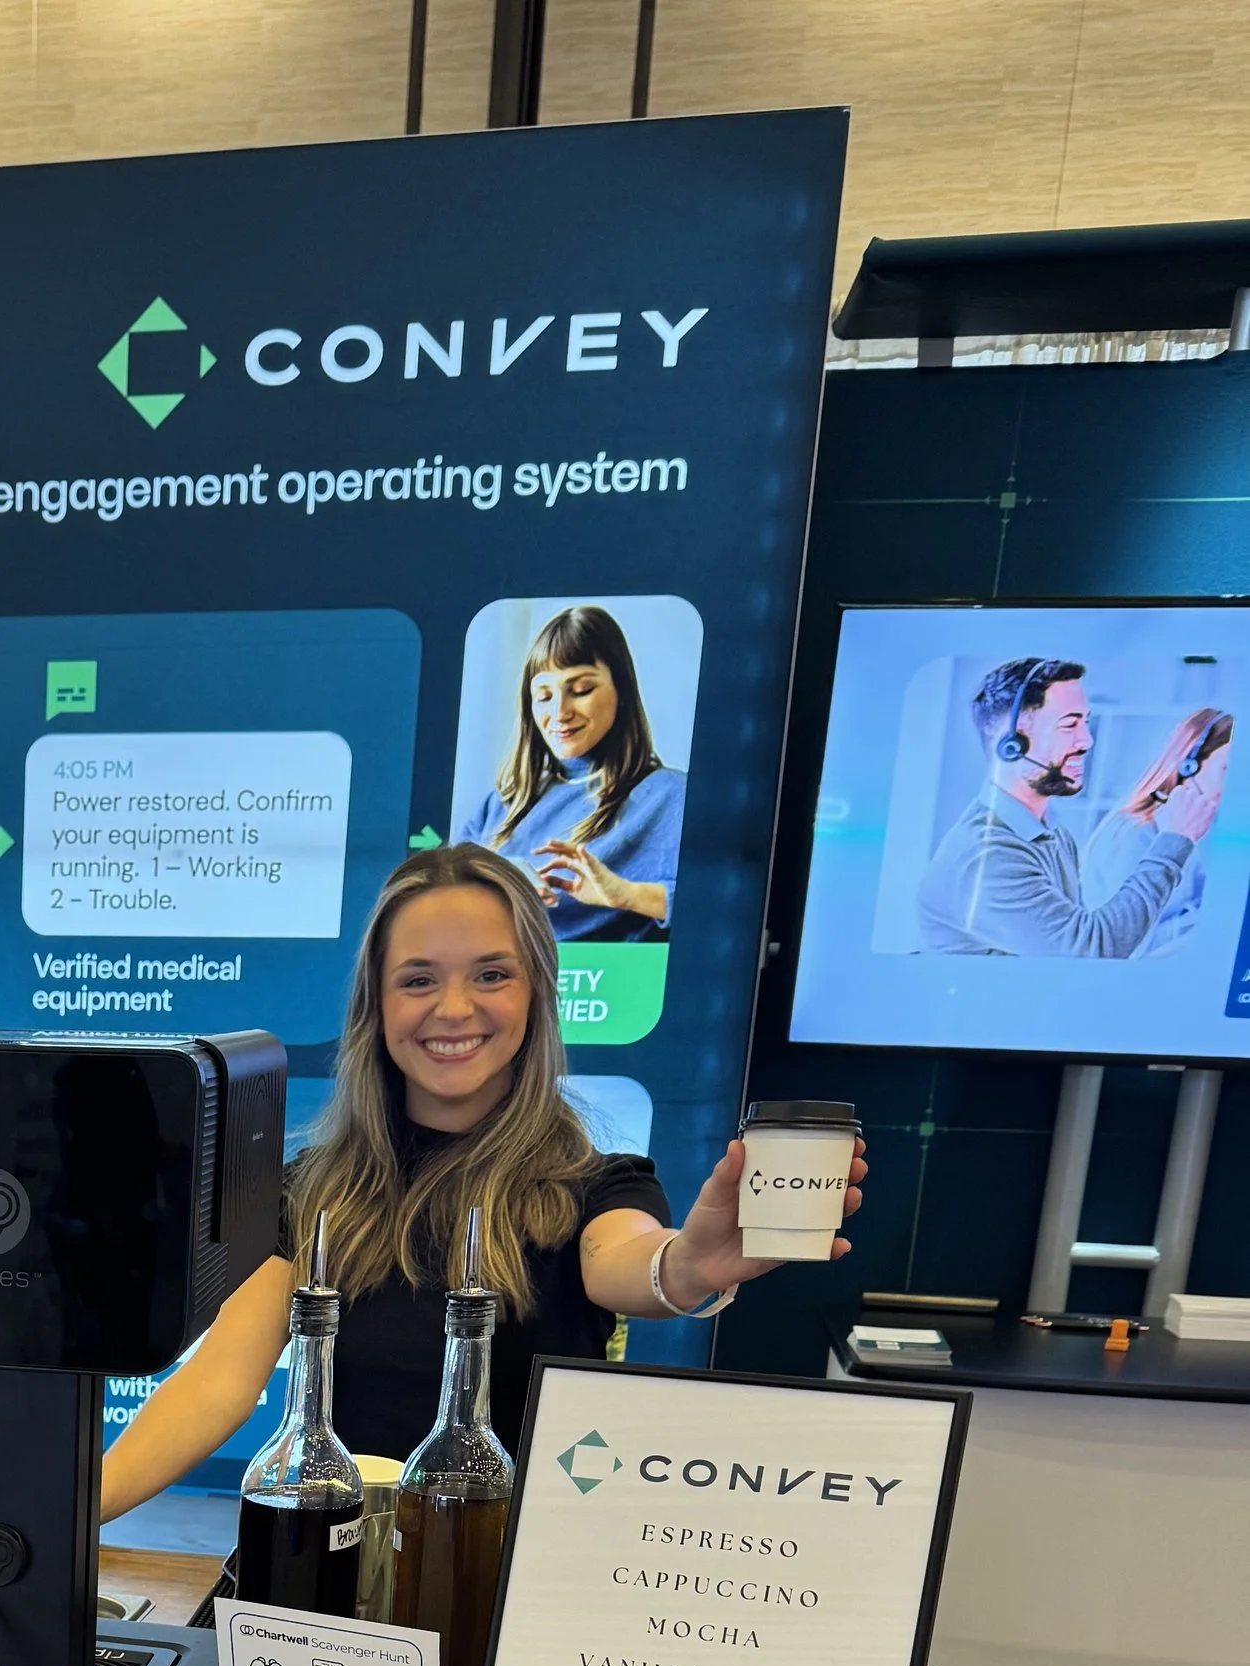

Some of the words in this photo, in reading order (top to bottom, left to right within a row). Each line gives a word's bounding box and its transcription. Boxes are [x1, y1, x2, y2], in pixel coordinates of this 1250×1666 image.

[244, 306, 710, 387] CONVEY
[277, 454, 503, 515] operating
[513, 451, 688, 508] system
[54, 760, 97, 779] 4:05
[103, 760, 133, 779] PM
[53, 791, 122, 812] Power
[128, 789, 230, 812] restored.
[237, 789, 332, 812] Confirm
[51, 827, 102, 850] your
[108, 823, 234, 851] equipment
[241, 822, 259, 845] is
[51, 856, 139, 883] running.
[152, 856, 159, 878] 1
[189, 856, 282, 884] Working
[50, 888, 64, 910] 2
[89, 888, 177, 911] Trouble.
[33, 952, 131, 980] Verified
[137, 953, 242, 981] medical
[557, 970, 604, 993] ETY
[32, 985, 173, 1016] equipment
[639, 1454, 903, 1506] CONVEY
[641, 1523, 799, 1559] ESPRESSO
[612, 1566, 820, 1609] CAPPUCCINO
[256, 1628, 309, 1647] Chartwell
[311, 1637, 376, 1659] Scavenger
[379, 1650, 410, 1665] Hunt
[646, 1616, 760, 1649] MOCHA
